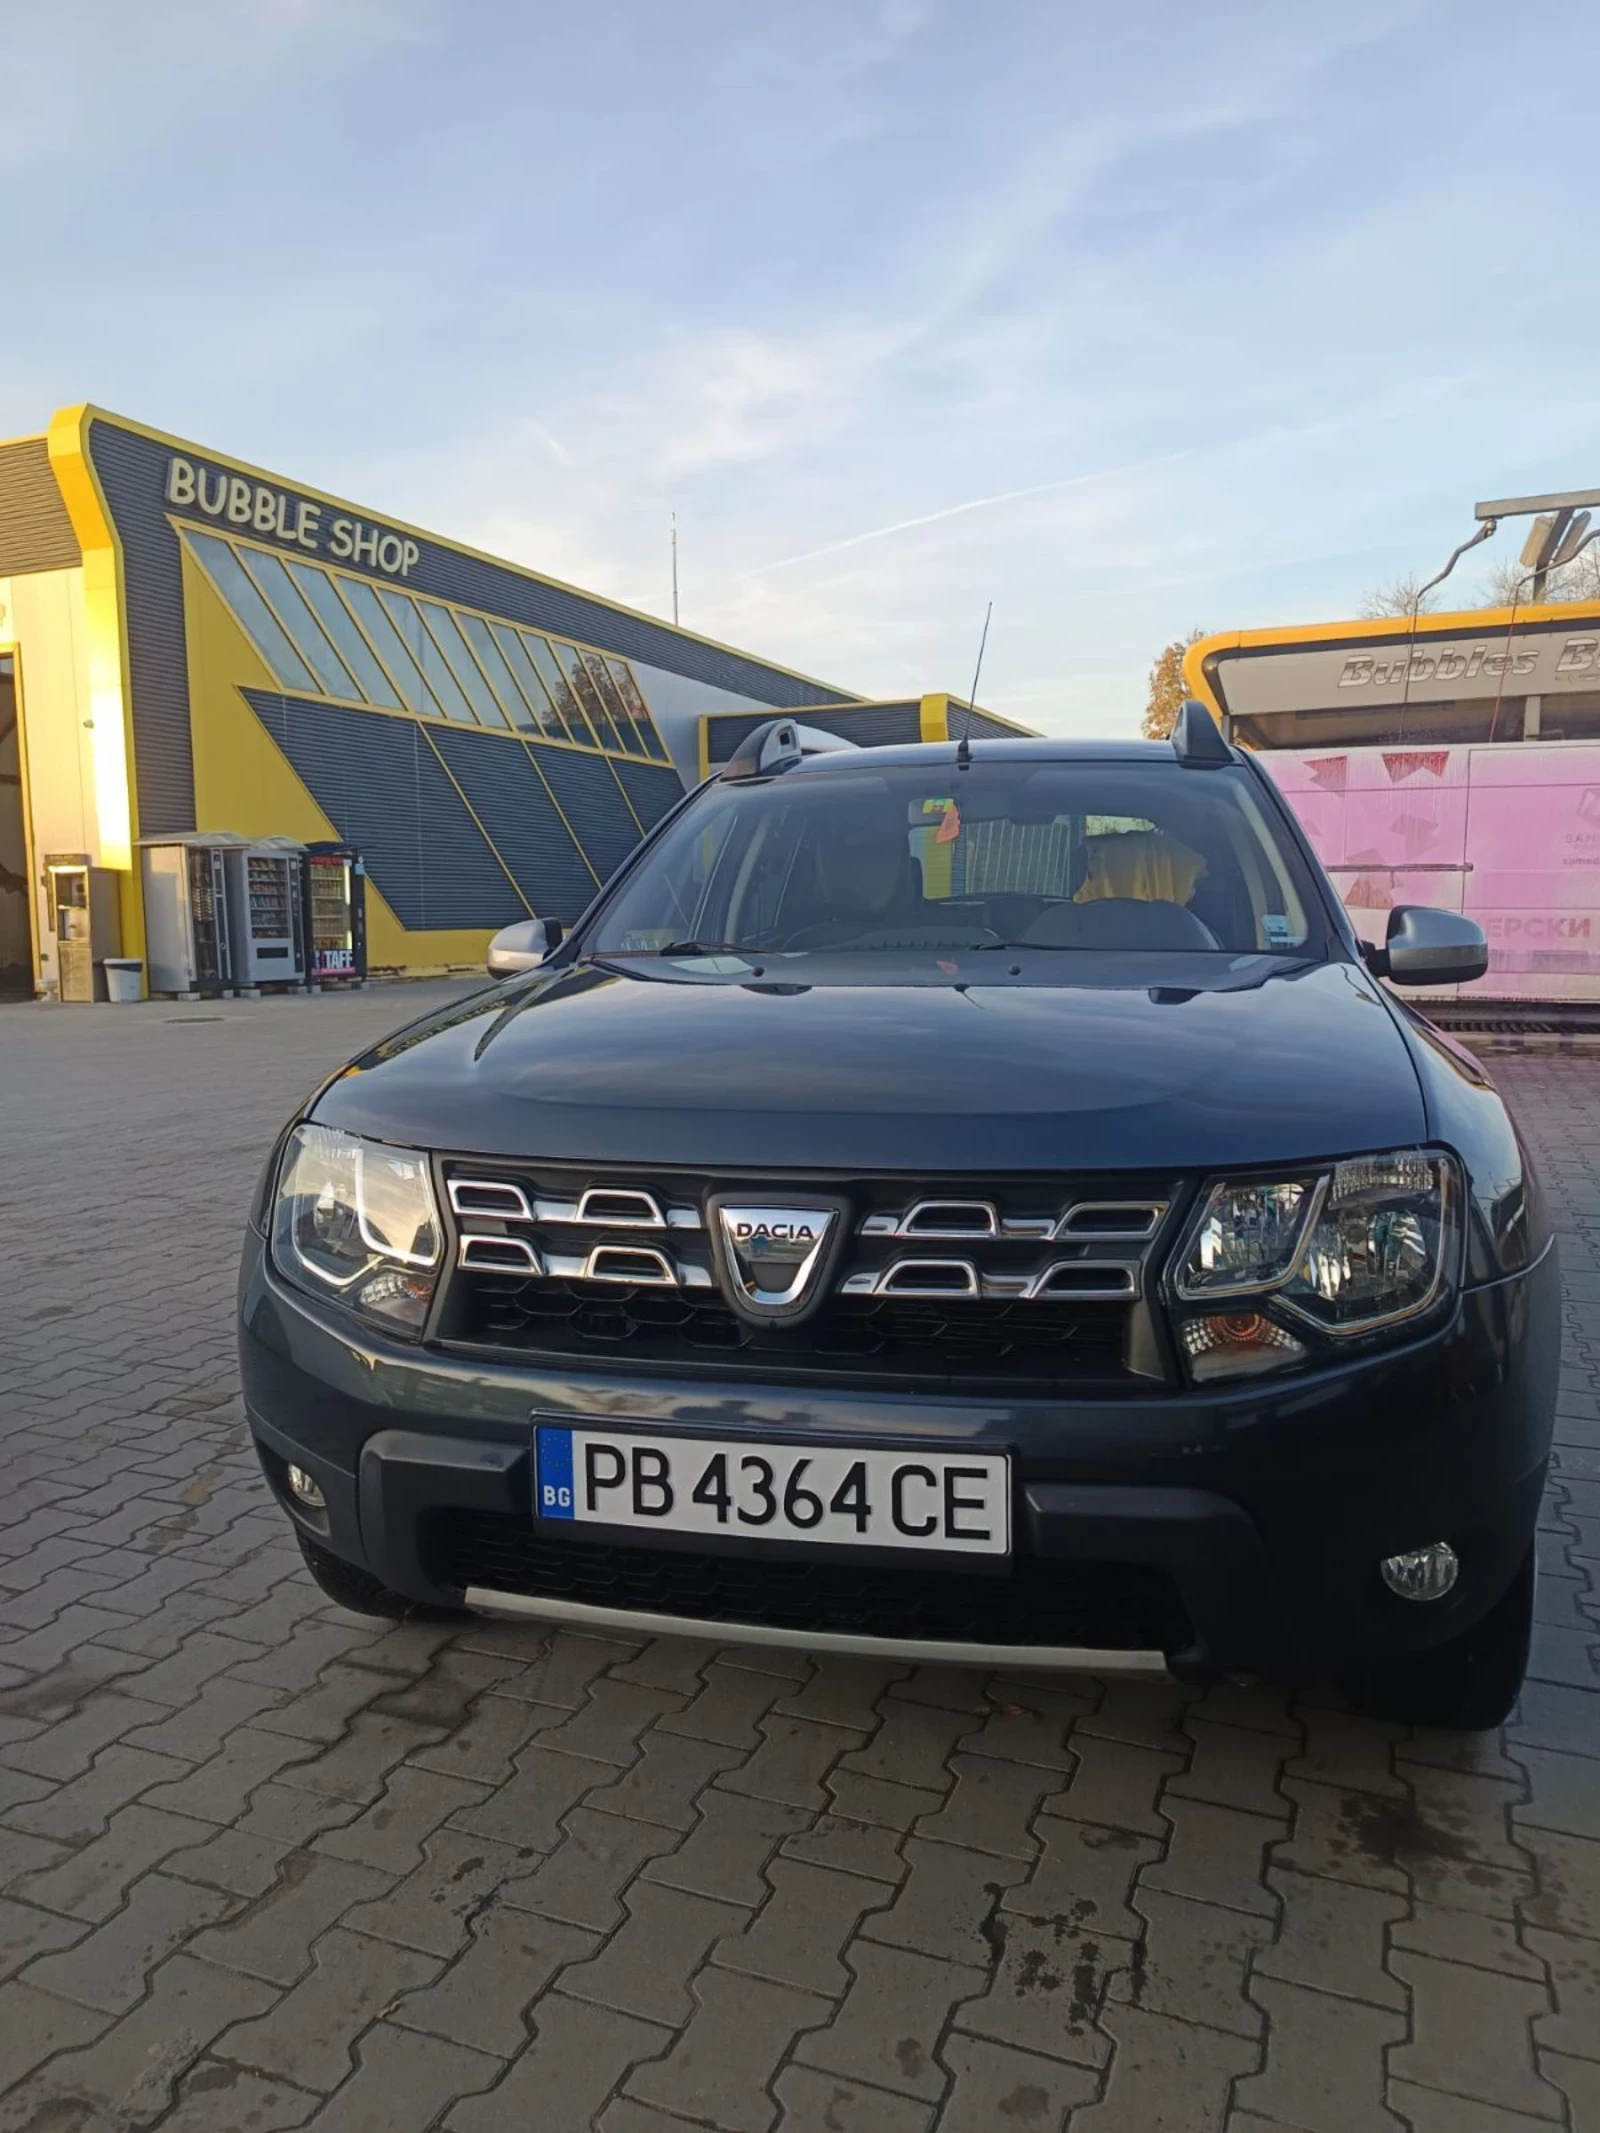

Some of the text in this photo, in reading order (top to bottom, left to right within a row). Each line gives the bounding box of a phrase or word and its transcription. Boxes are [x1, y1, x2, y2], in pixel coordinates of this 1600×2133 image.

[168, 457, 420, 577] BUBBLE SHOP
[1337, 638, 1600, 688] Bubbles B
[736, 1223, 814, 1239] DACIA
[543, 1485, 571, 1507] BG
[584, 1443, 991, 1541] PB 4364 CE
